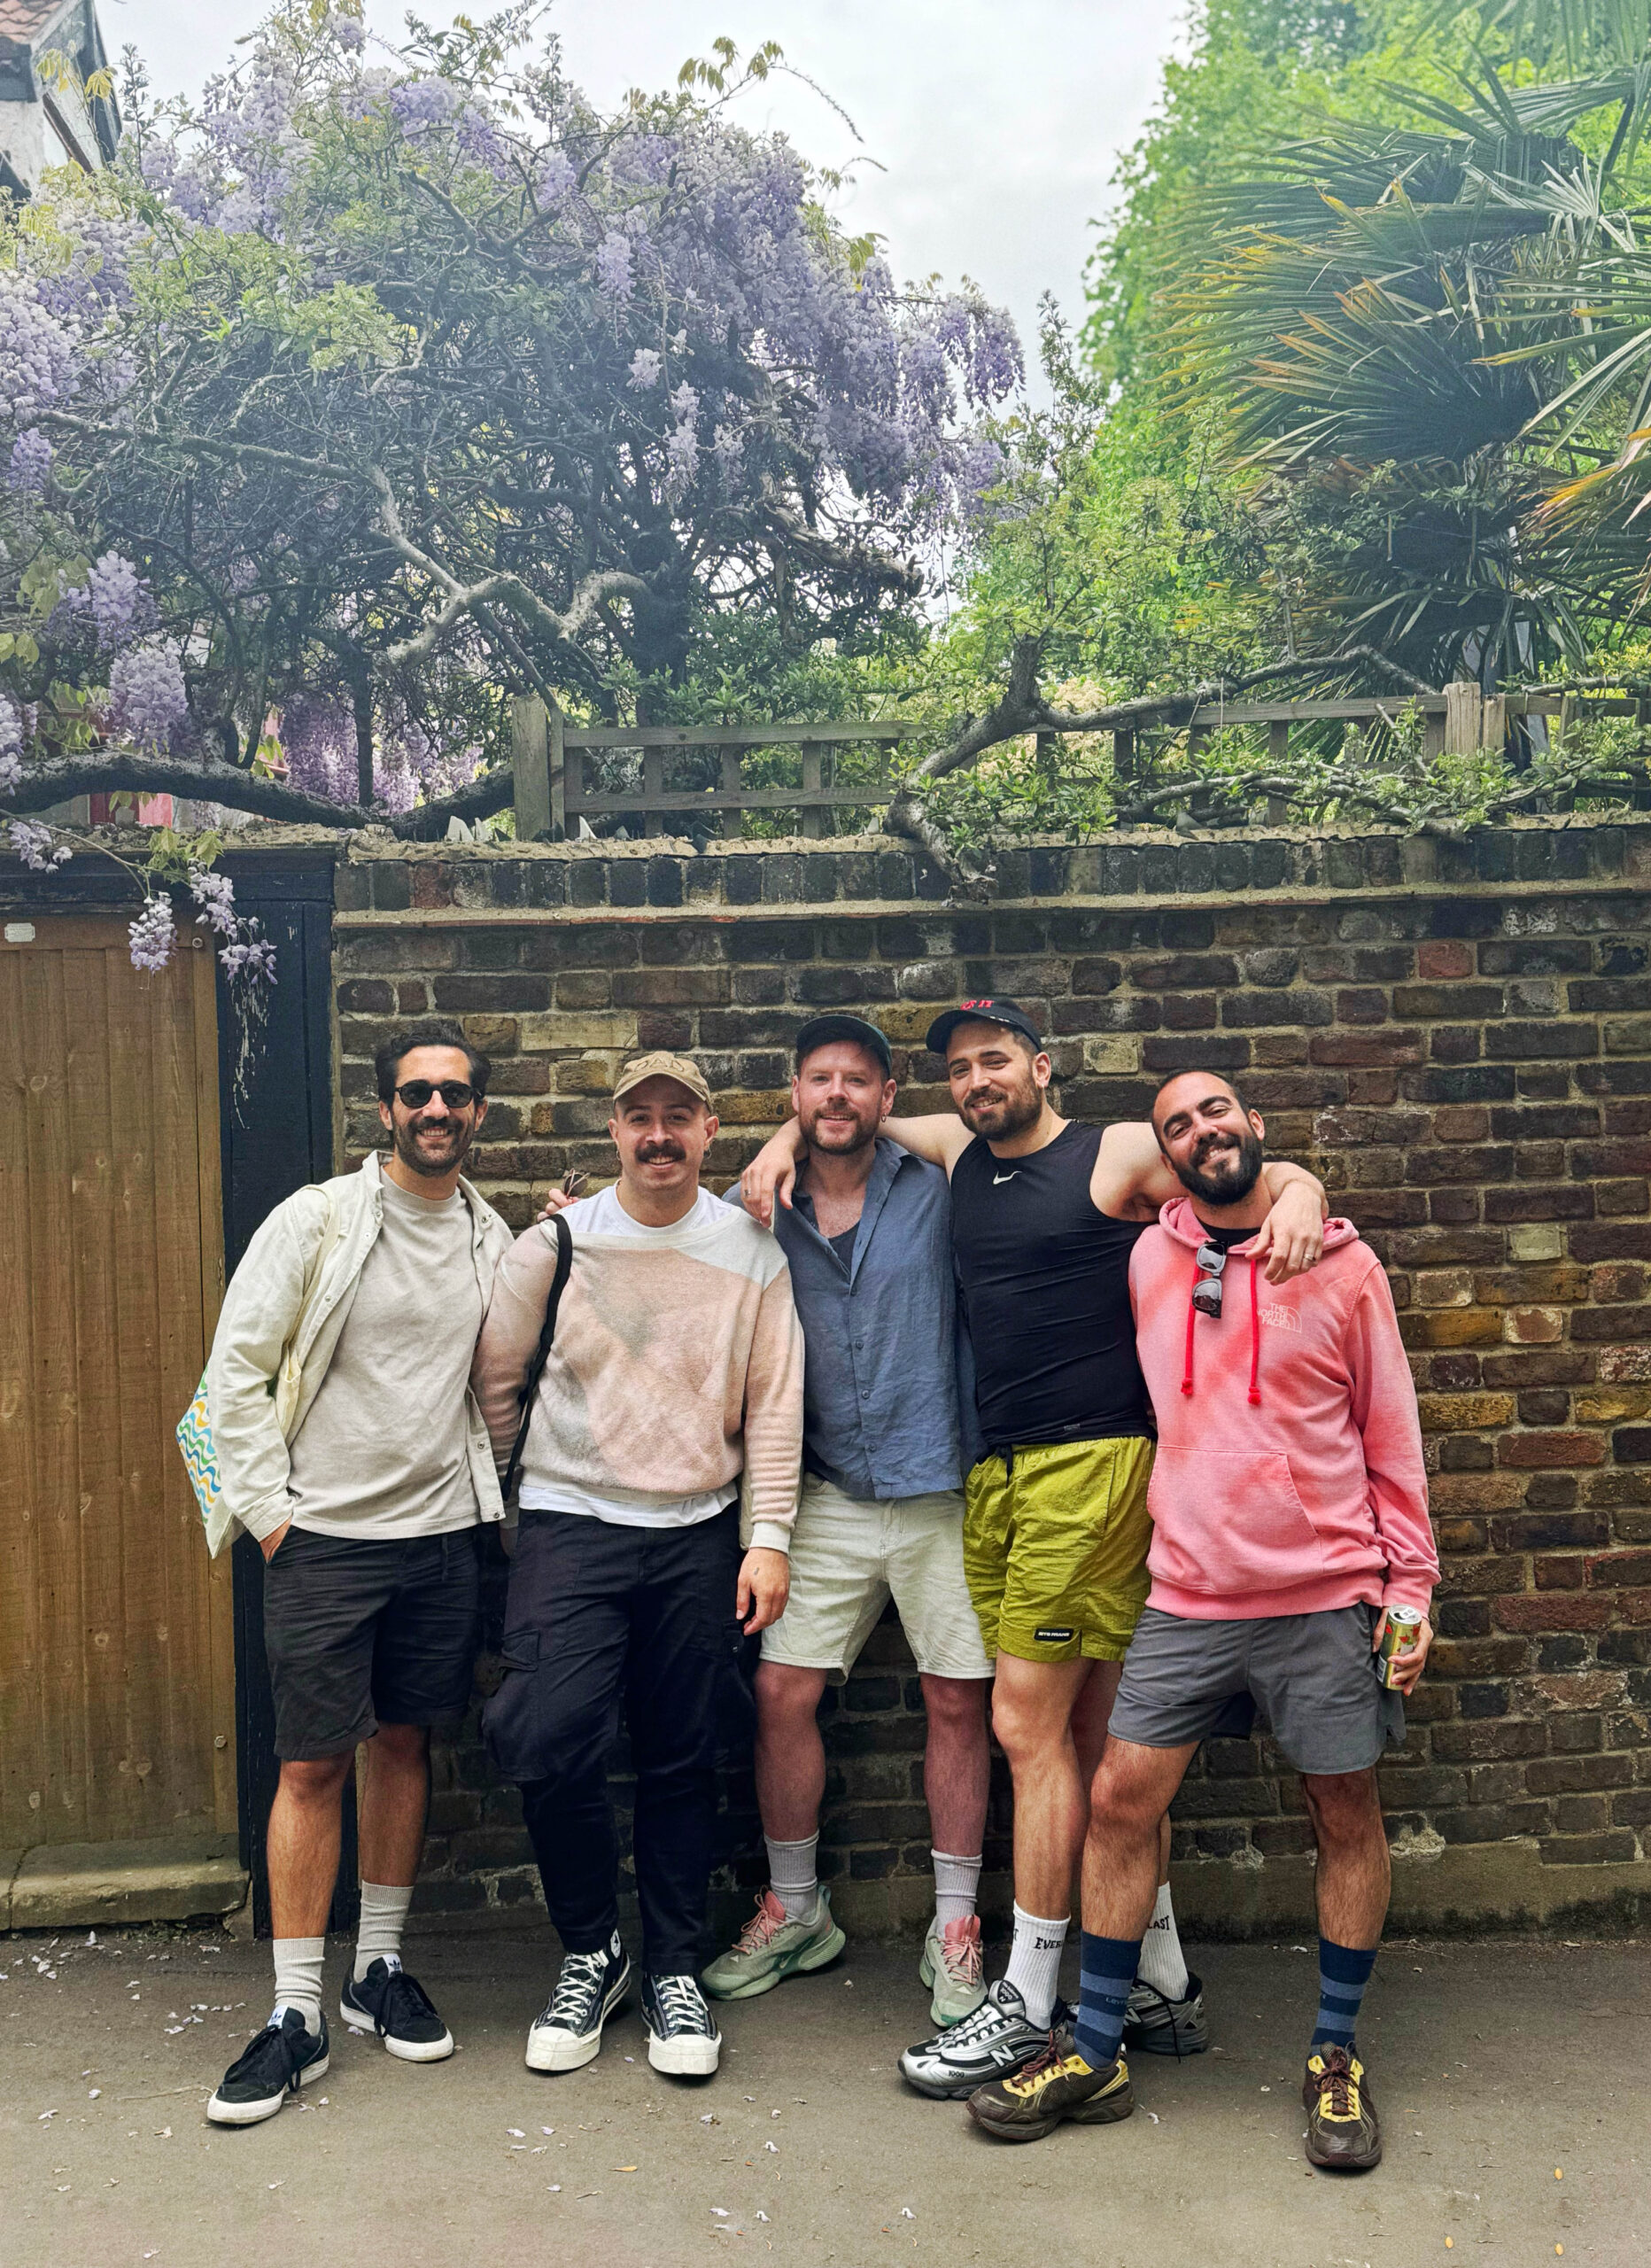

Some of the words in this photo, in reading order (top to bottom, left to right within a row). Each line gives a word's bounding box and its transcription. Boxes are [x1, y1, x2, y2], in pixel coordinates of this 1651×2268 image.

[633, 1057, 685, 1072] DAD
[1269, 1302, 1288, 1313] THE
[1262, 1317, 1286, 1329] FACE
